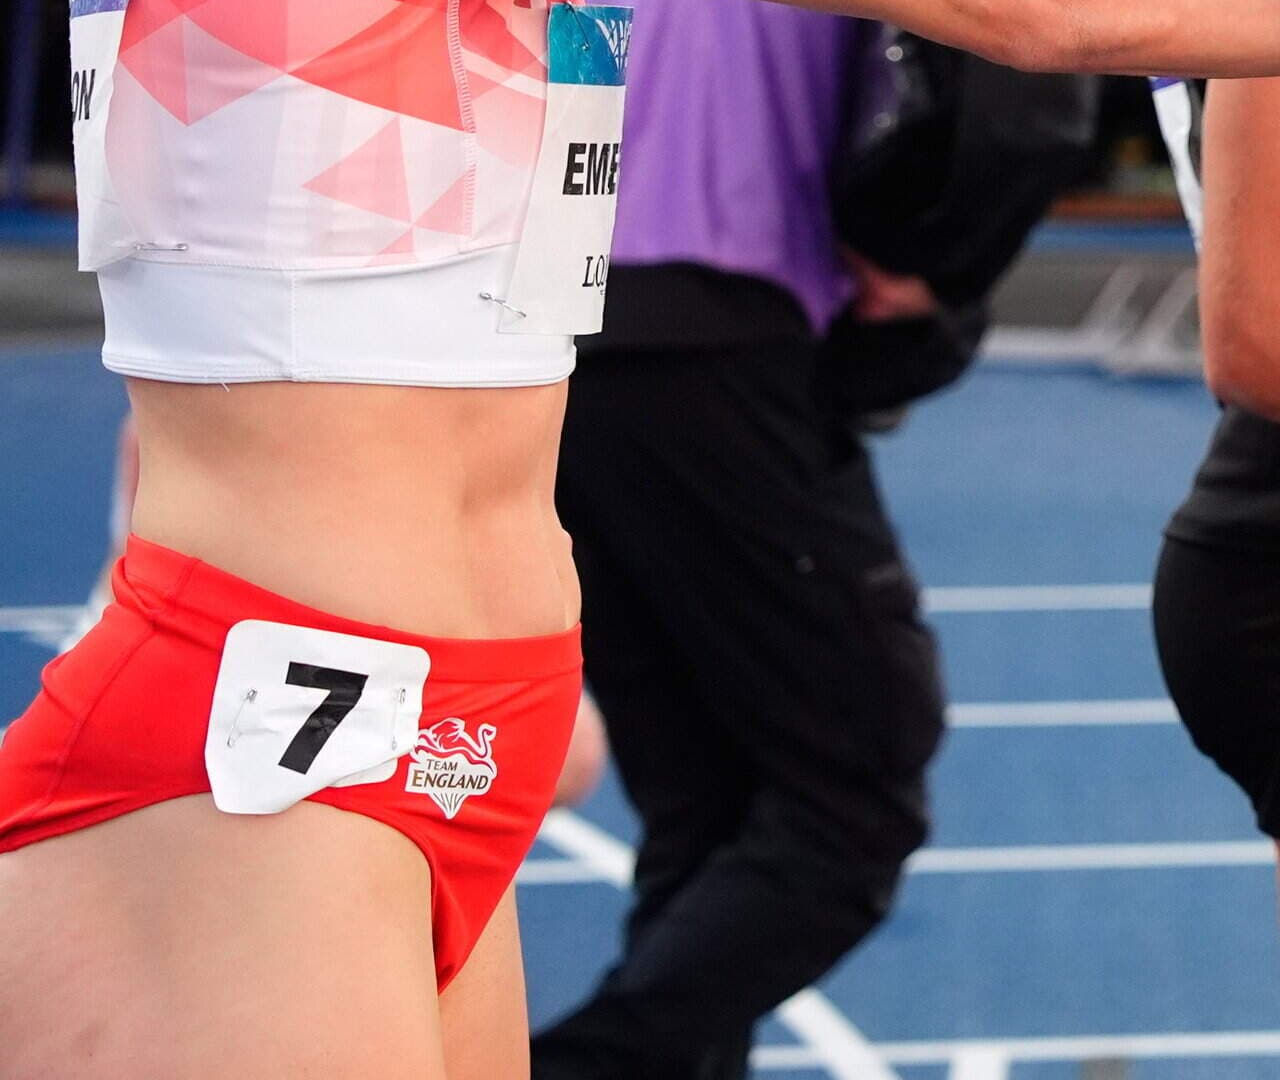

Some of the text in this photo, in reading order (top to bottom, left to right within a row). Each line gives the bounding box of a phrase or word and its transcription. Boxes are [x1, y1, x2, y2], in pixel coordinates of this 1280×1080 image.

[277, 661, 369, 775] 7
[426, 758, 458, 771] TEAM
[411, 770, 490, 790] ENGLAND
